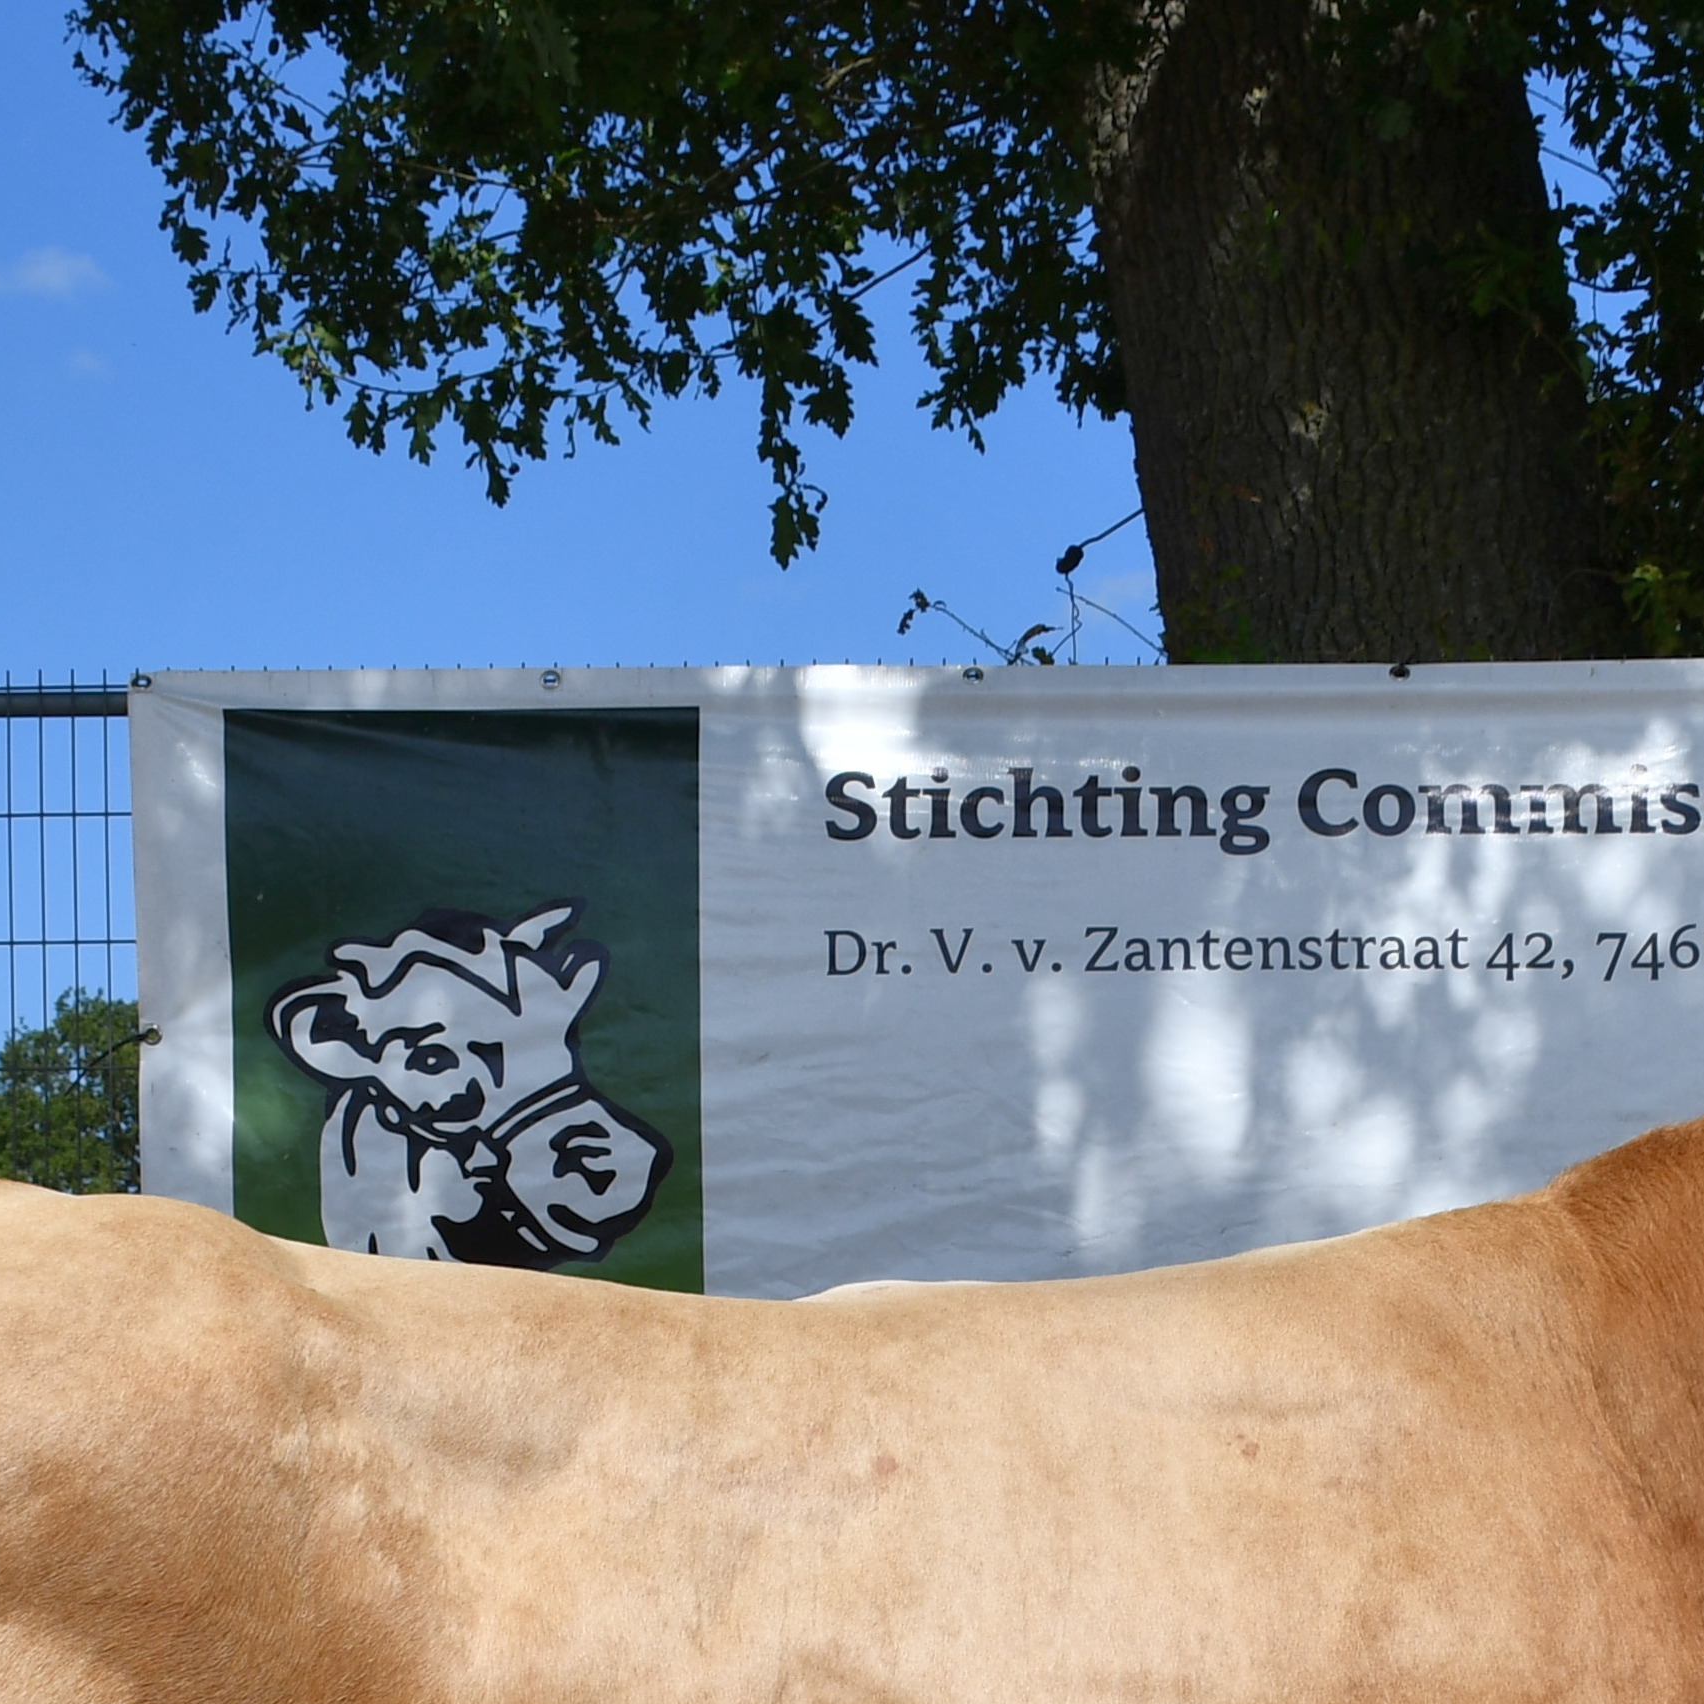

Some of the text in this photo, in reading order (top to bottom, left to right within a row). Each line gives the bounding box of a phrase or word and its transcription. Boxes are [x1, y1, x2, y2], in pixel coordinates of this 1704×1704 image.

[825, 766, 1271, 856] Stichting
[823, 930, 913, 976] Dr.
[929, 927, 993, 975] V.
[1010, 938, 1063, 973] v.
[1084, 926, 1470, 973] Zantenstraat
[1485, 931, 1575, 982] 42,
